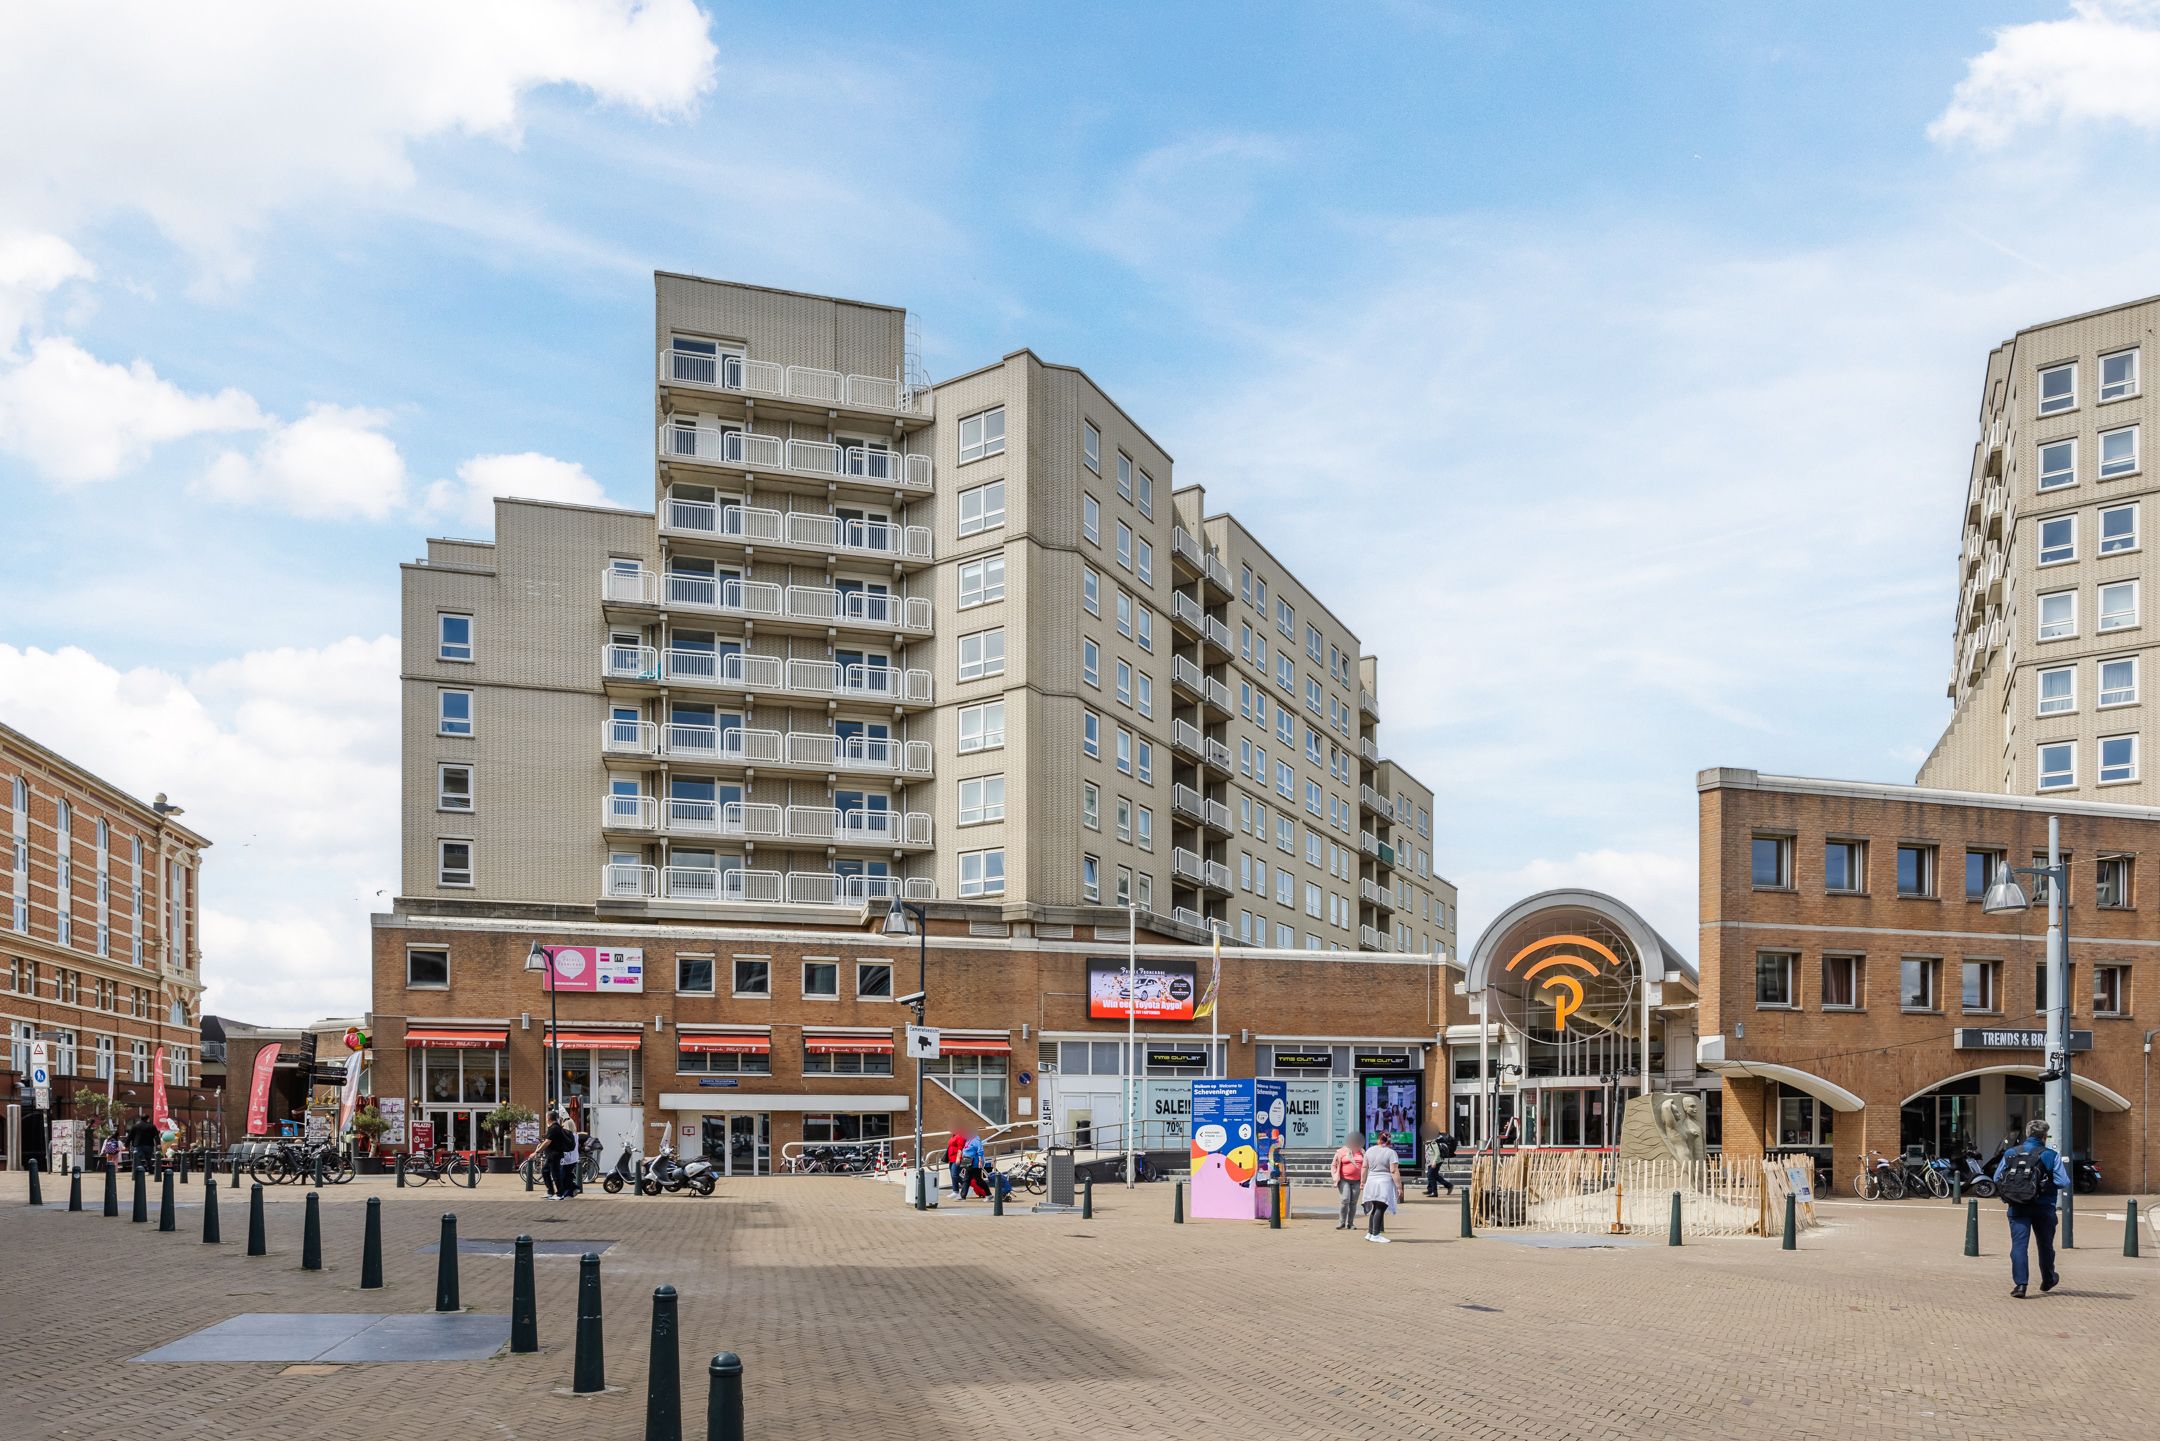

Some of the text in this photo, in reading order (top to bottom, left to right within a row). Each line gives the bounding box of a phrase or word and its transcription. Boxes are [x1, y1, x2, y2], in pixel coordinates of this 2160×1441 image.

[1102, 999, 1119, 1009] Win
[1135, 1000, 1161, 1010] Toyota
[1161, 1001, 1183, 1011] Aygo!
[1982, 1032, 2020, 1046] TRENDS
[2021, 1033, 2029, 1047] &
[1193, 1088, 1237, 1096] Scheveningen
[1166, 1121, 1182, 1133] 70%
[1292, 1121, 1309, 1133] 70%
